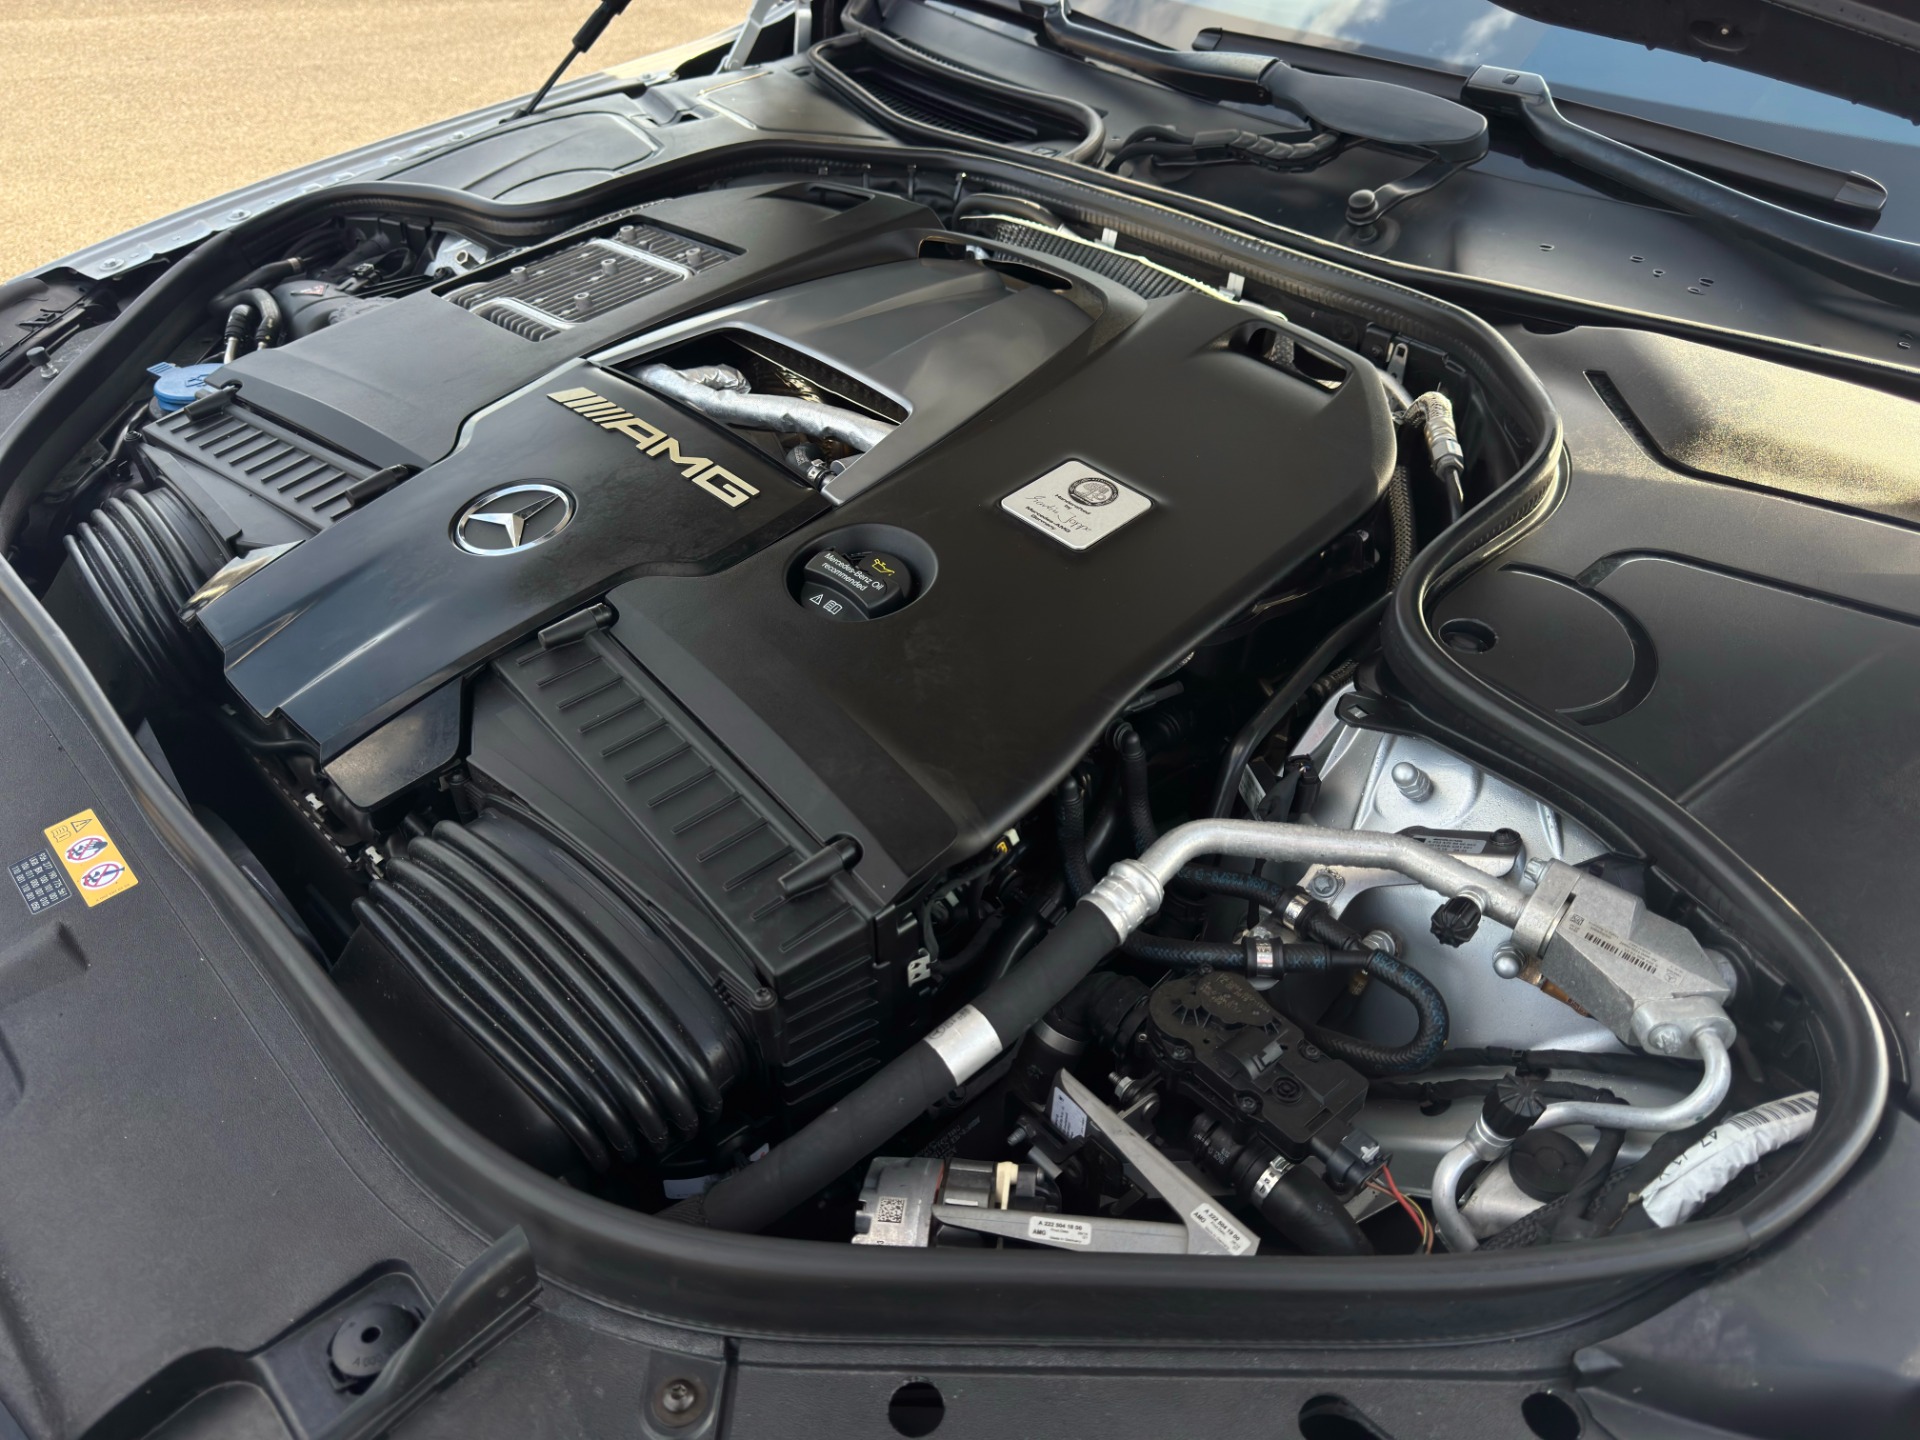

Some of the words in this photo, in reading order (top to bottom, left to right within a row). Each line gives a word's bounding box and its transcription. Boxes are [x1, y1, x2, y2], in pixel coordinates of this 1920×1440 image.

[599, 416, 761, 509] AMG
[821, 562, 868, 592] recommended
[824, 552, 873, 584] Mercedes-Benz
[871, 580, 885, 591] Oil
[1032, 1228, 1047, 1236] AMG
[1193, 1212, 1207, 1223] AMG
